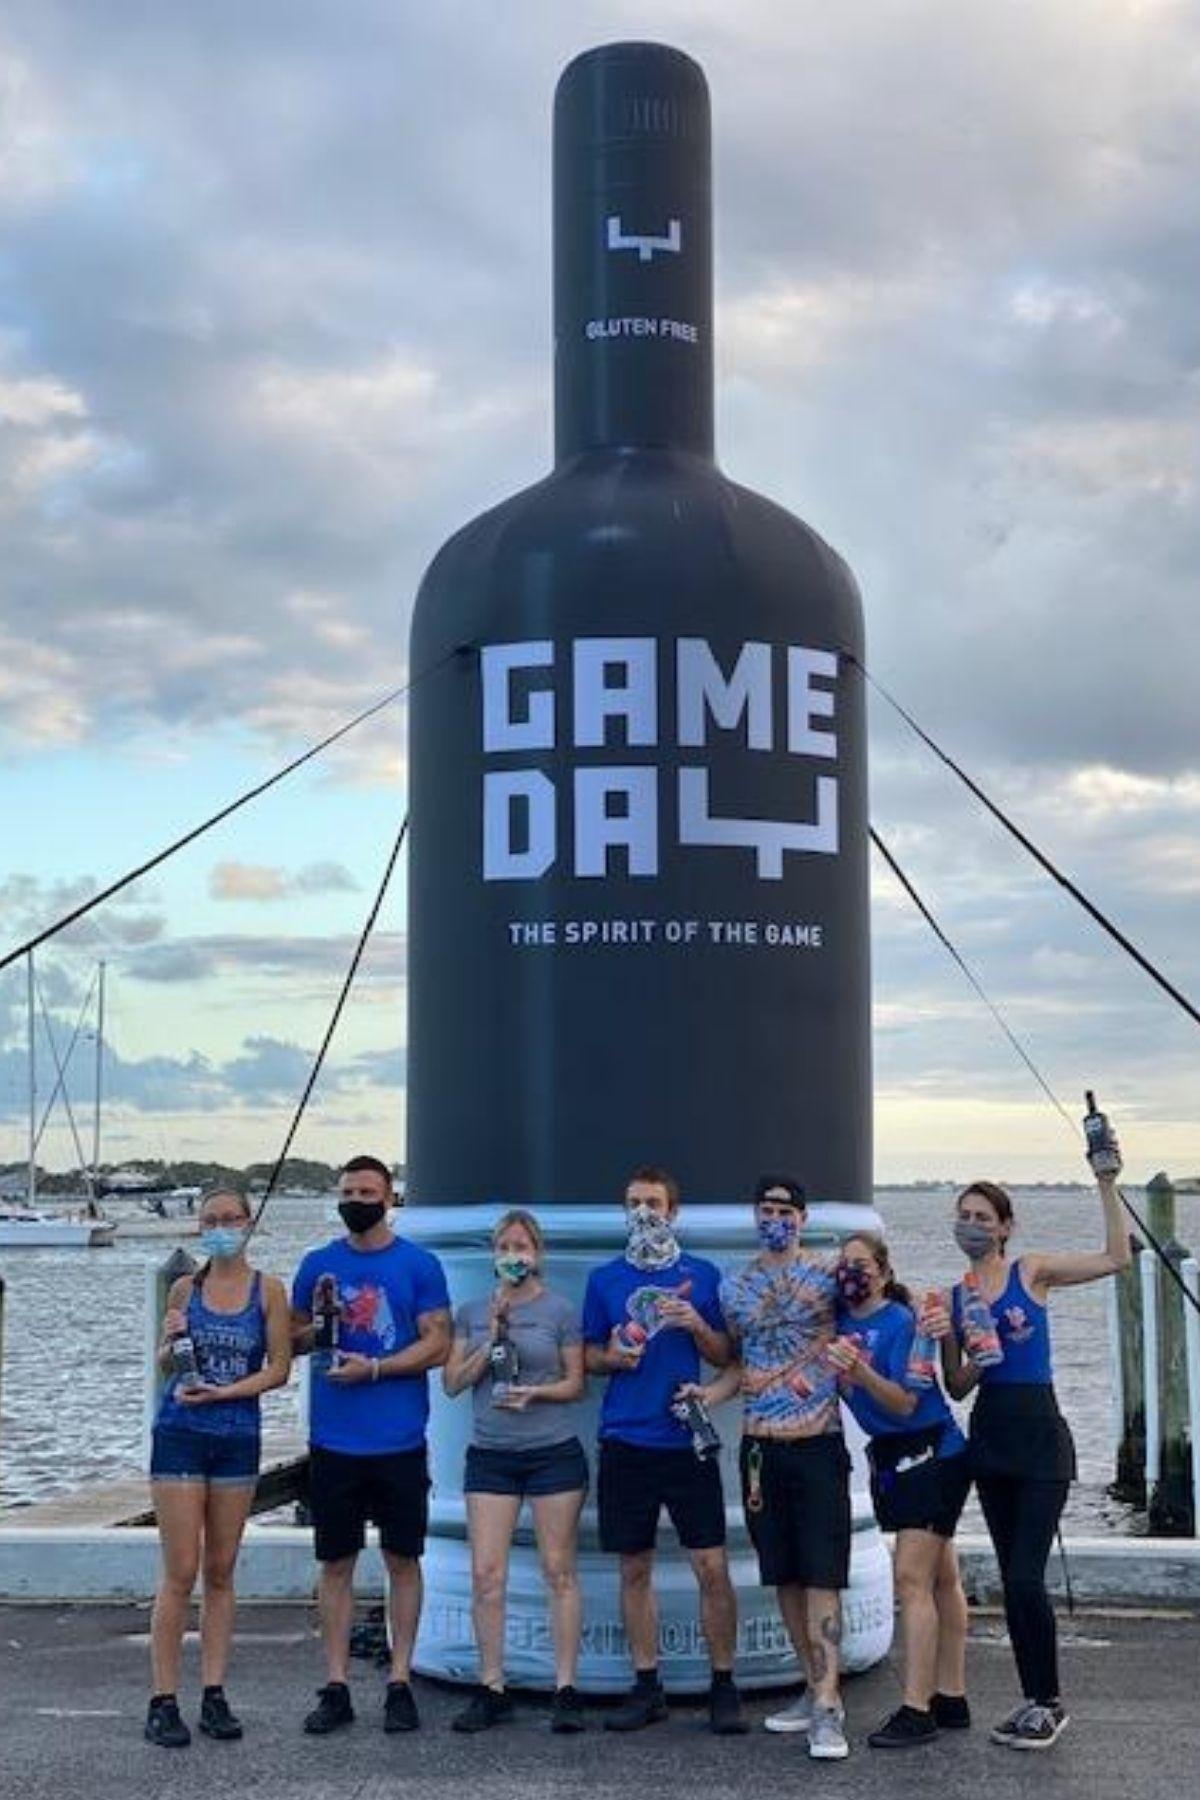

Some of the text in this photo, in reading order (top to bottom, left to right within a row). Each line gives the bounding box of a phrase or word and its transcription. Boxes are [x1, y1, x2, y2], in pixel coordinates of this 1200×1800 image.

[585, 318, 698, 343] GLUTEN FREE
[481, 638, 838, 759] GAME
[482, 766, 840, 880] DAY
[509, 921, 823, 946] THE SPIRIT OF THE GAME
